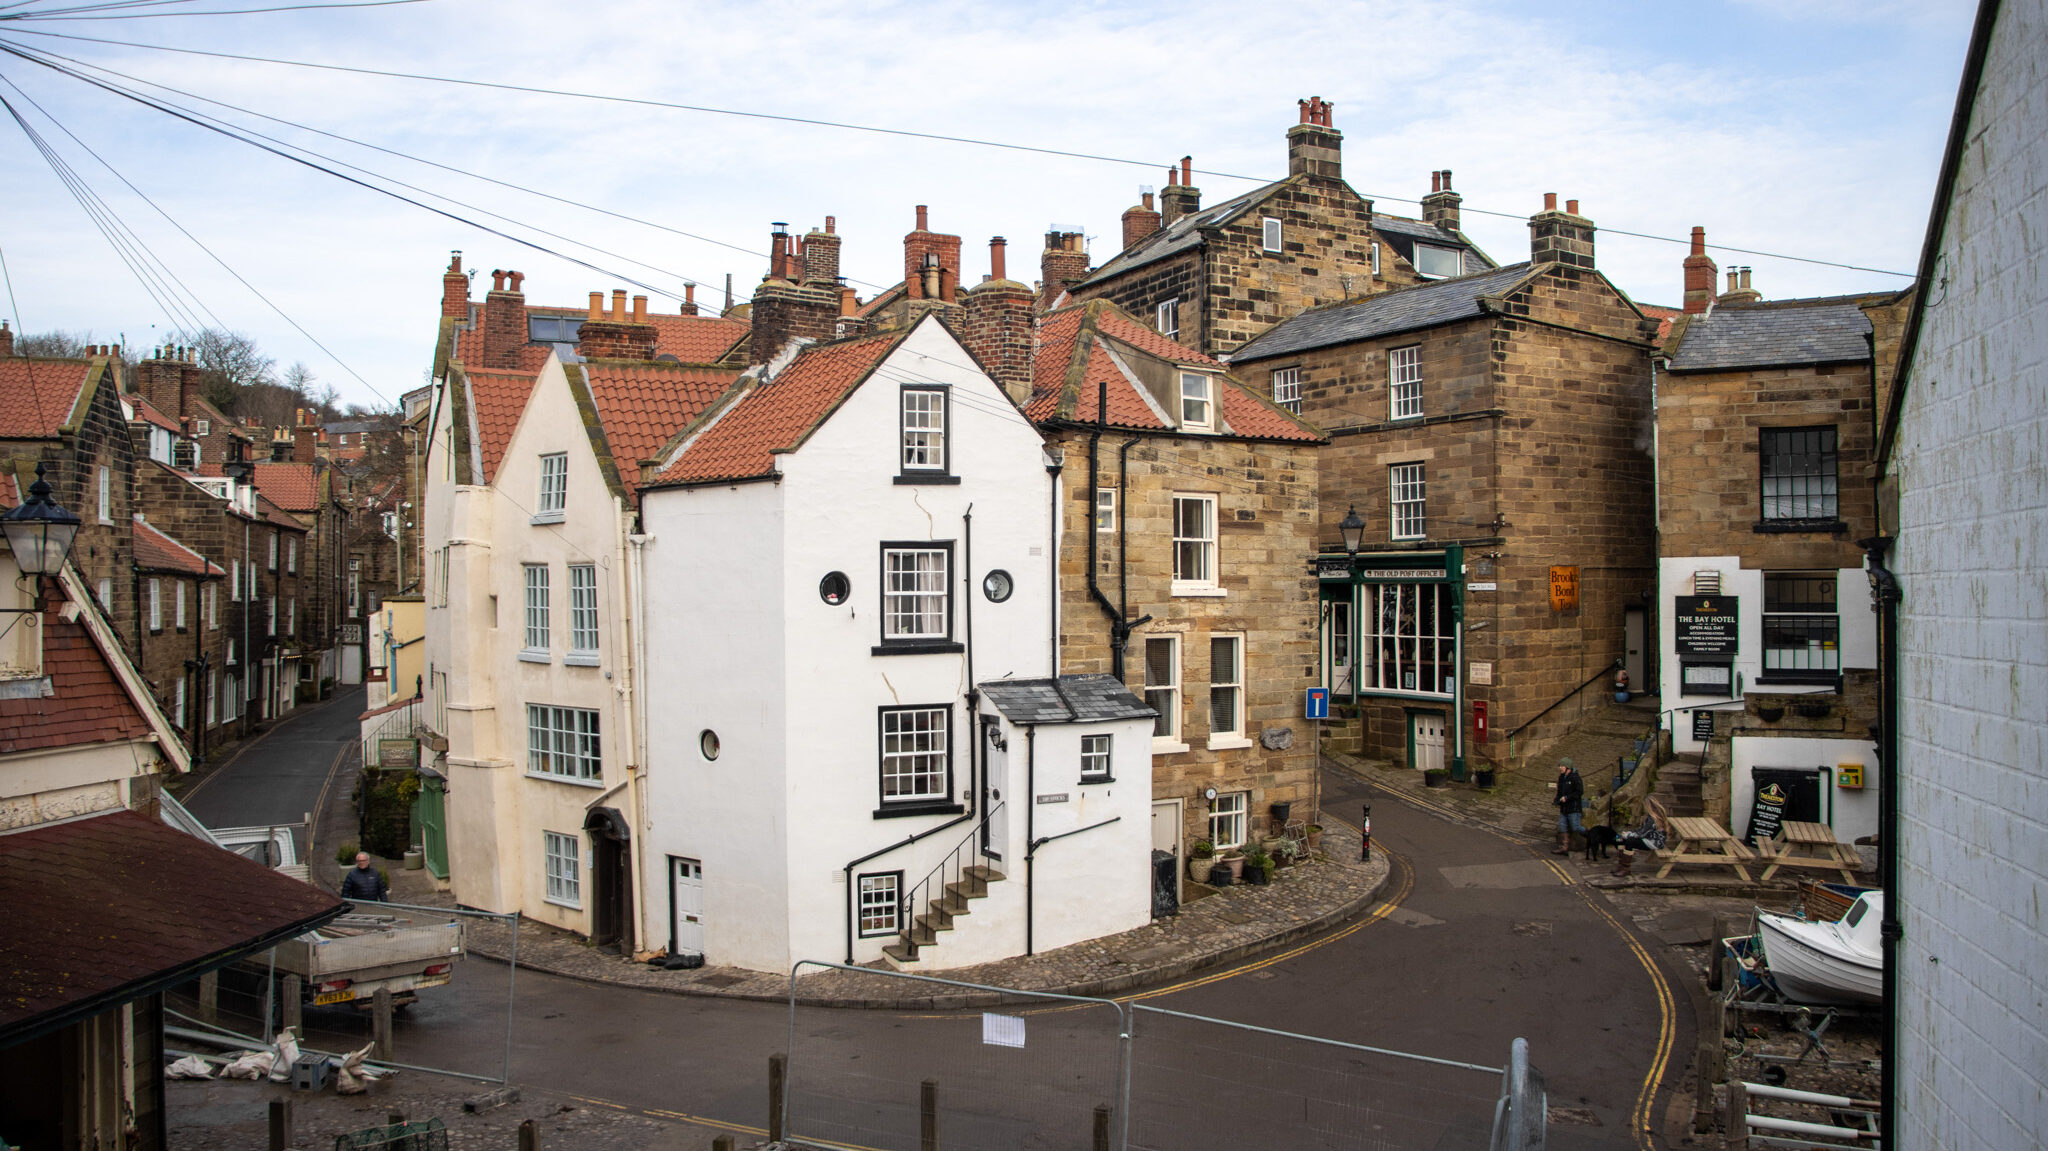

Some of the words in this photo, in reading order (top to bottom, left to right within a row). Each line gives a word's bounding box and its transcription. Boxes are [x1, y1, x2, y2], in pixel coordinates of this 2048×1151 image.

[1551, 571, 1578, 583] Brooke
[1555, 585, 1575, 597] Bond
[1766, 805, 1782, 814] HOTEL
